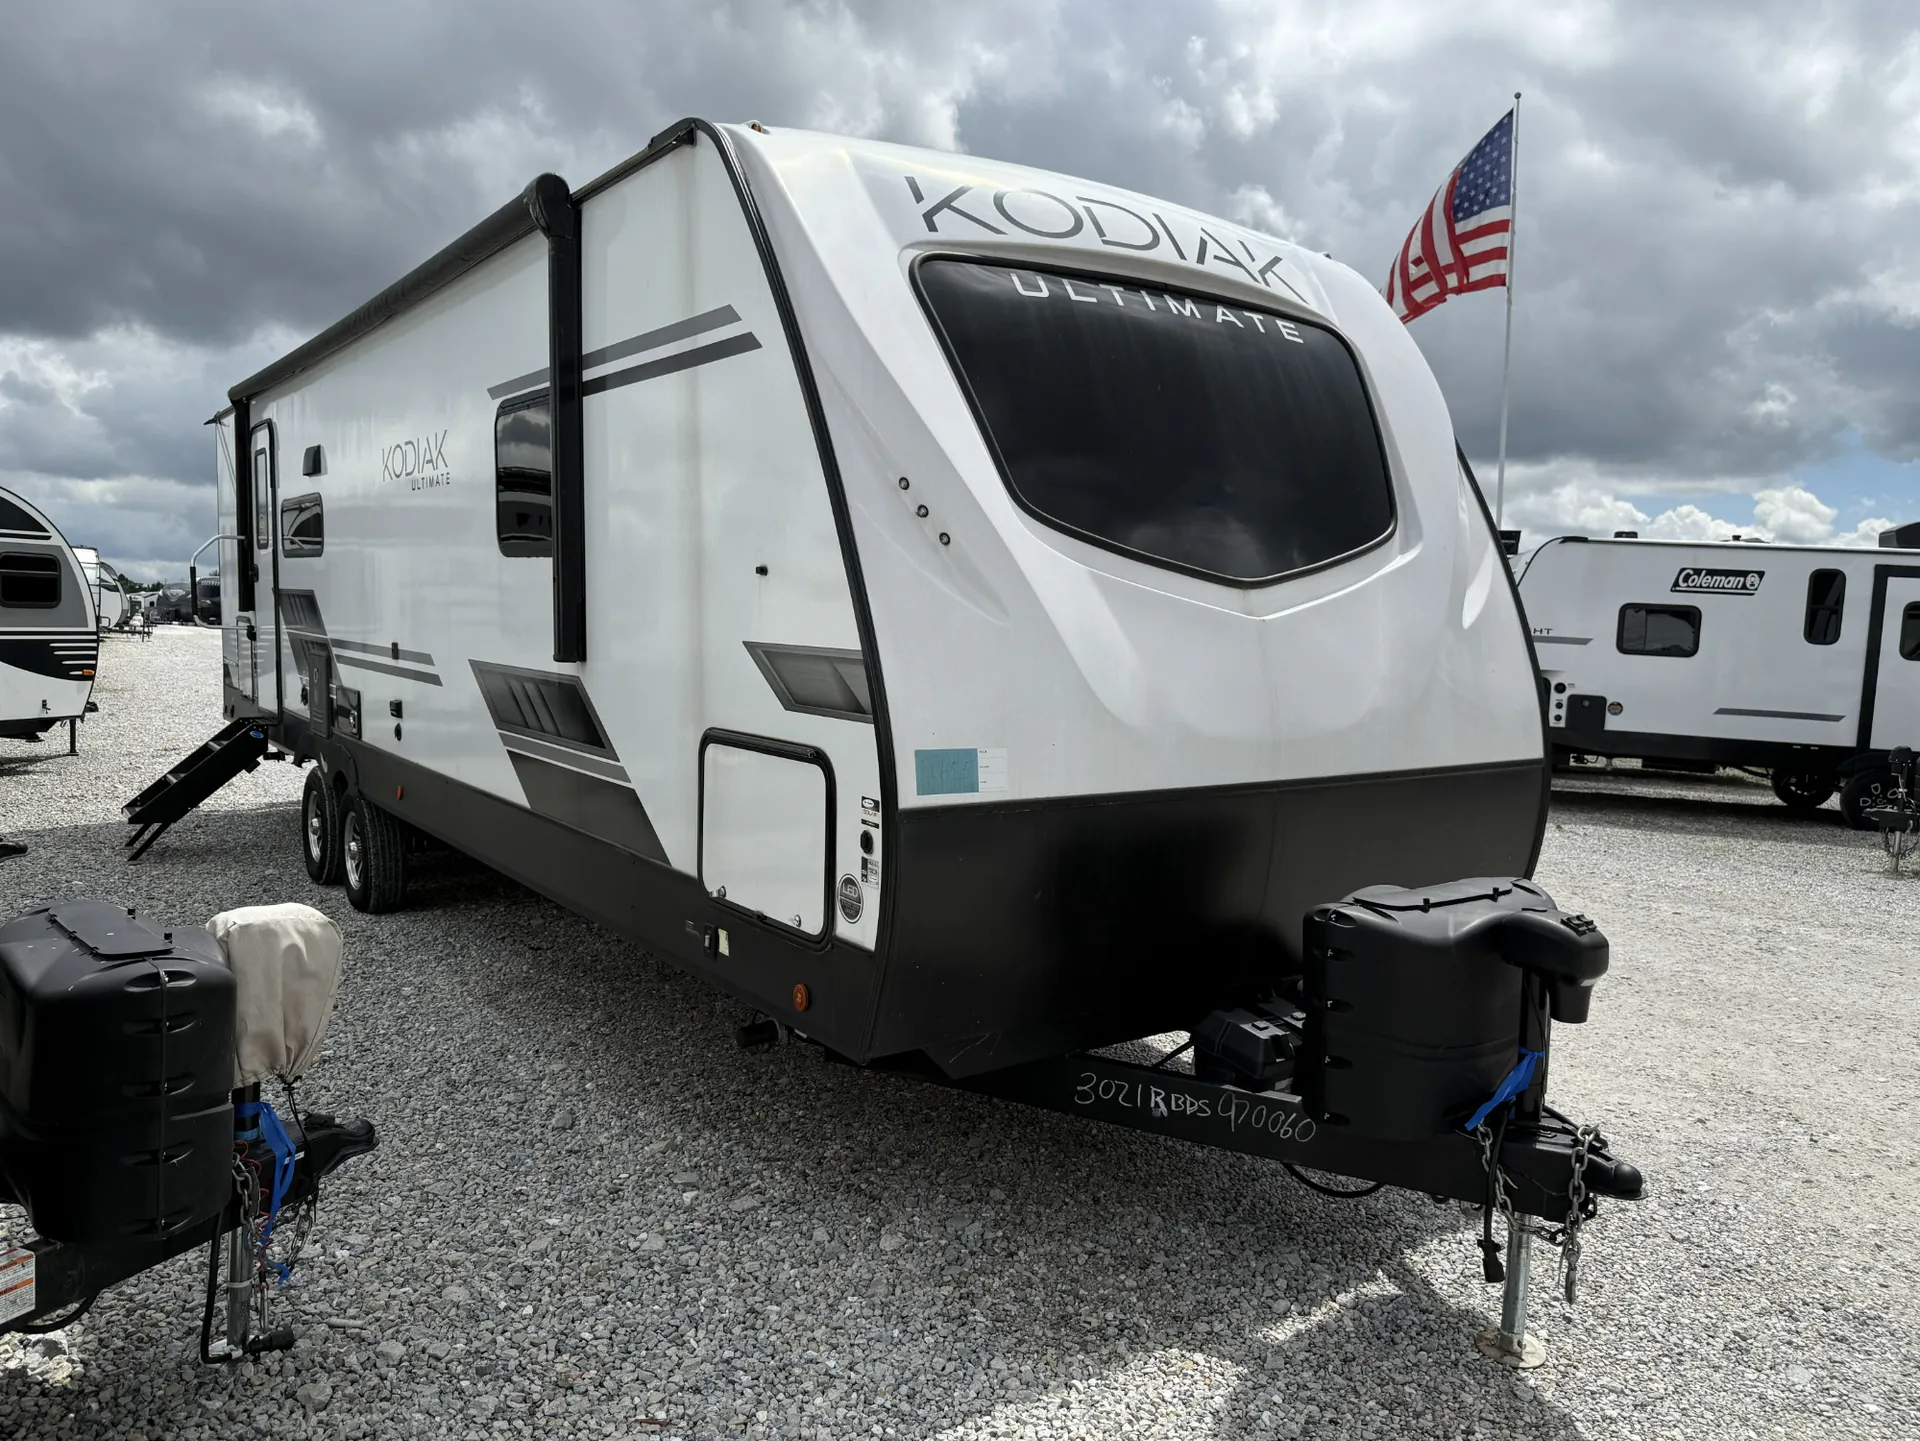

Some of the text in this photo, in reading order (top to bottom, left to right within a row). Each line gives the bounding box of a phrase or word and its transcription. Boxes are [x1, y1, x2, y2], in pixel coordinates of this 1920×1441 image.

[904, 176, 1310, 305] KODIAK
[1010, 271, 1304, 344] ULTIMATE
[382, 429, 448, 482] KODIAK
[411, 472, 450, 491] ULTIMATE
[1678, 569, 1745, 589] Coleman
[1530, 627, 1553, 635] HT
[842, 882, 859, 898] LED
